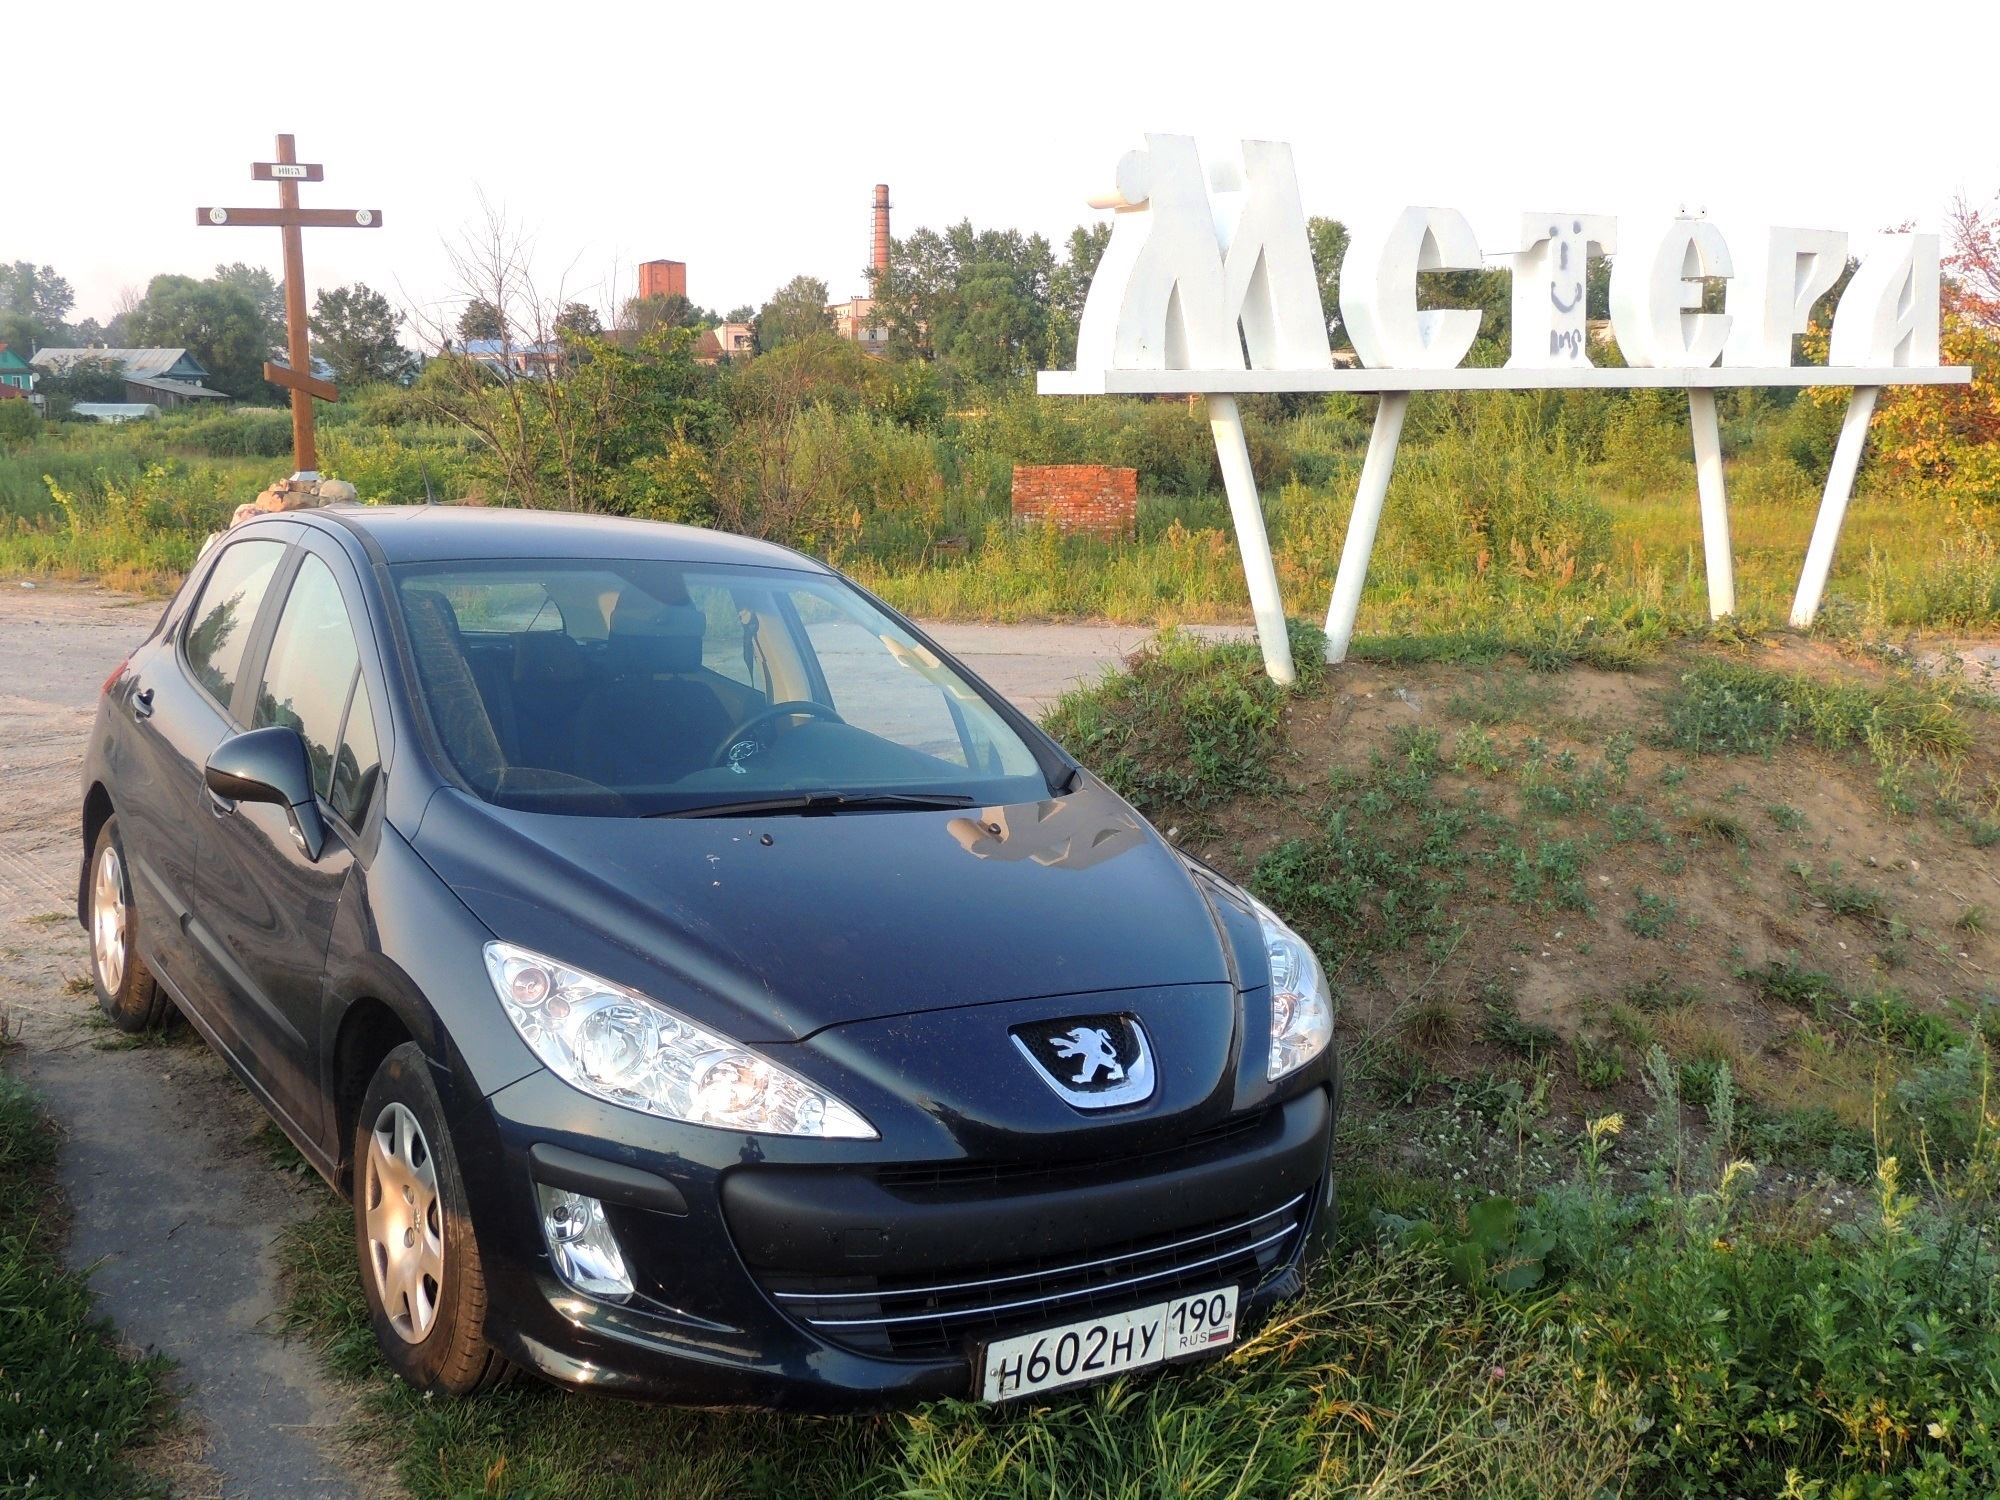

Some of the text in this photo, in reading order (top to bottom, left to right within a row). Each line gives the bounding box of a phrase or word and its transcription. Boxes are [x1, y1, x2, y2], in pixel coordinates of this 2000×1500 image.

[999, 1294, 1226, 1393] Н602НУ 190
[1179, 1332, 1207, 1349] RUS
